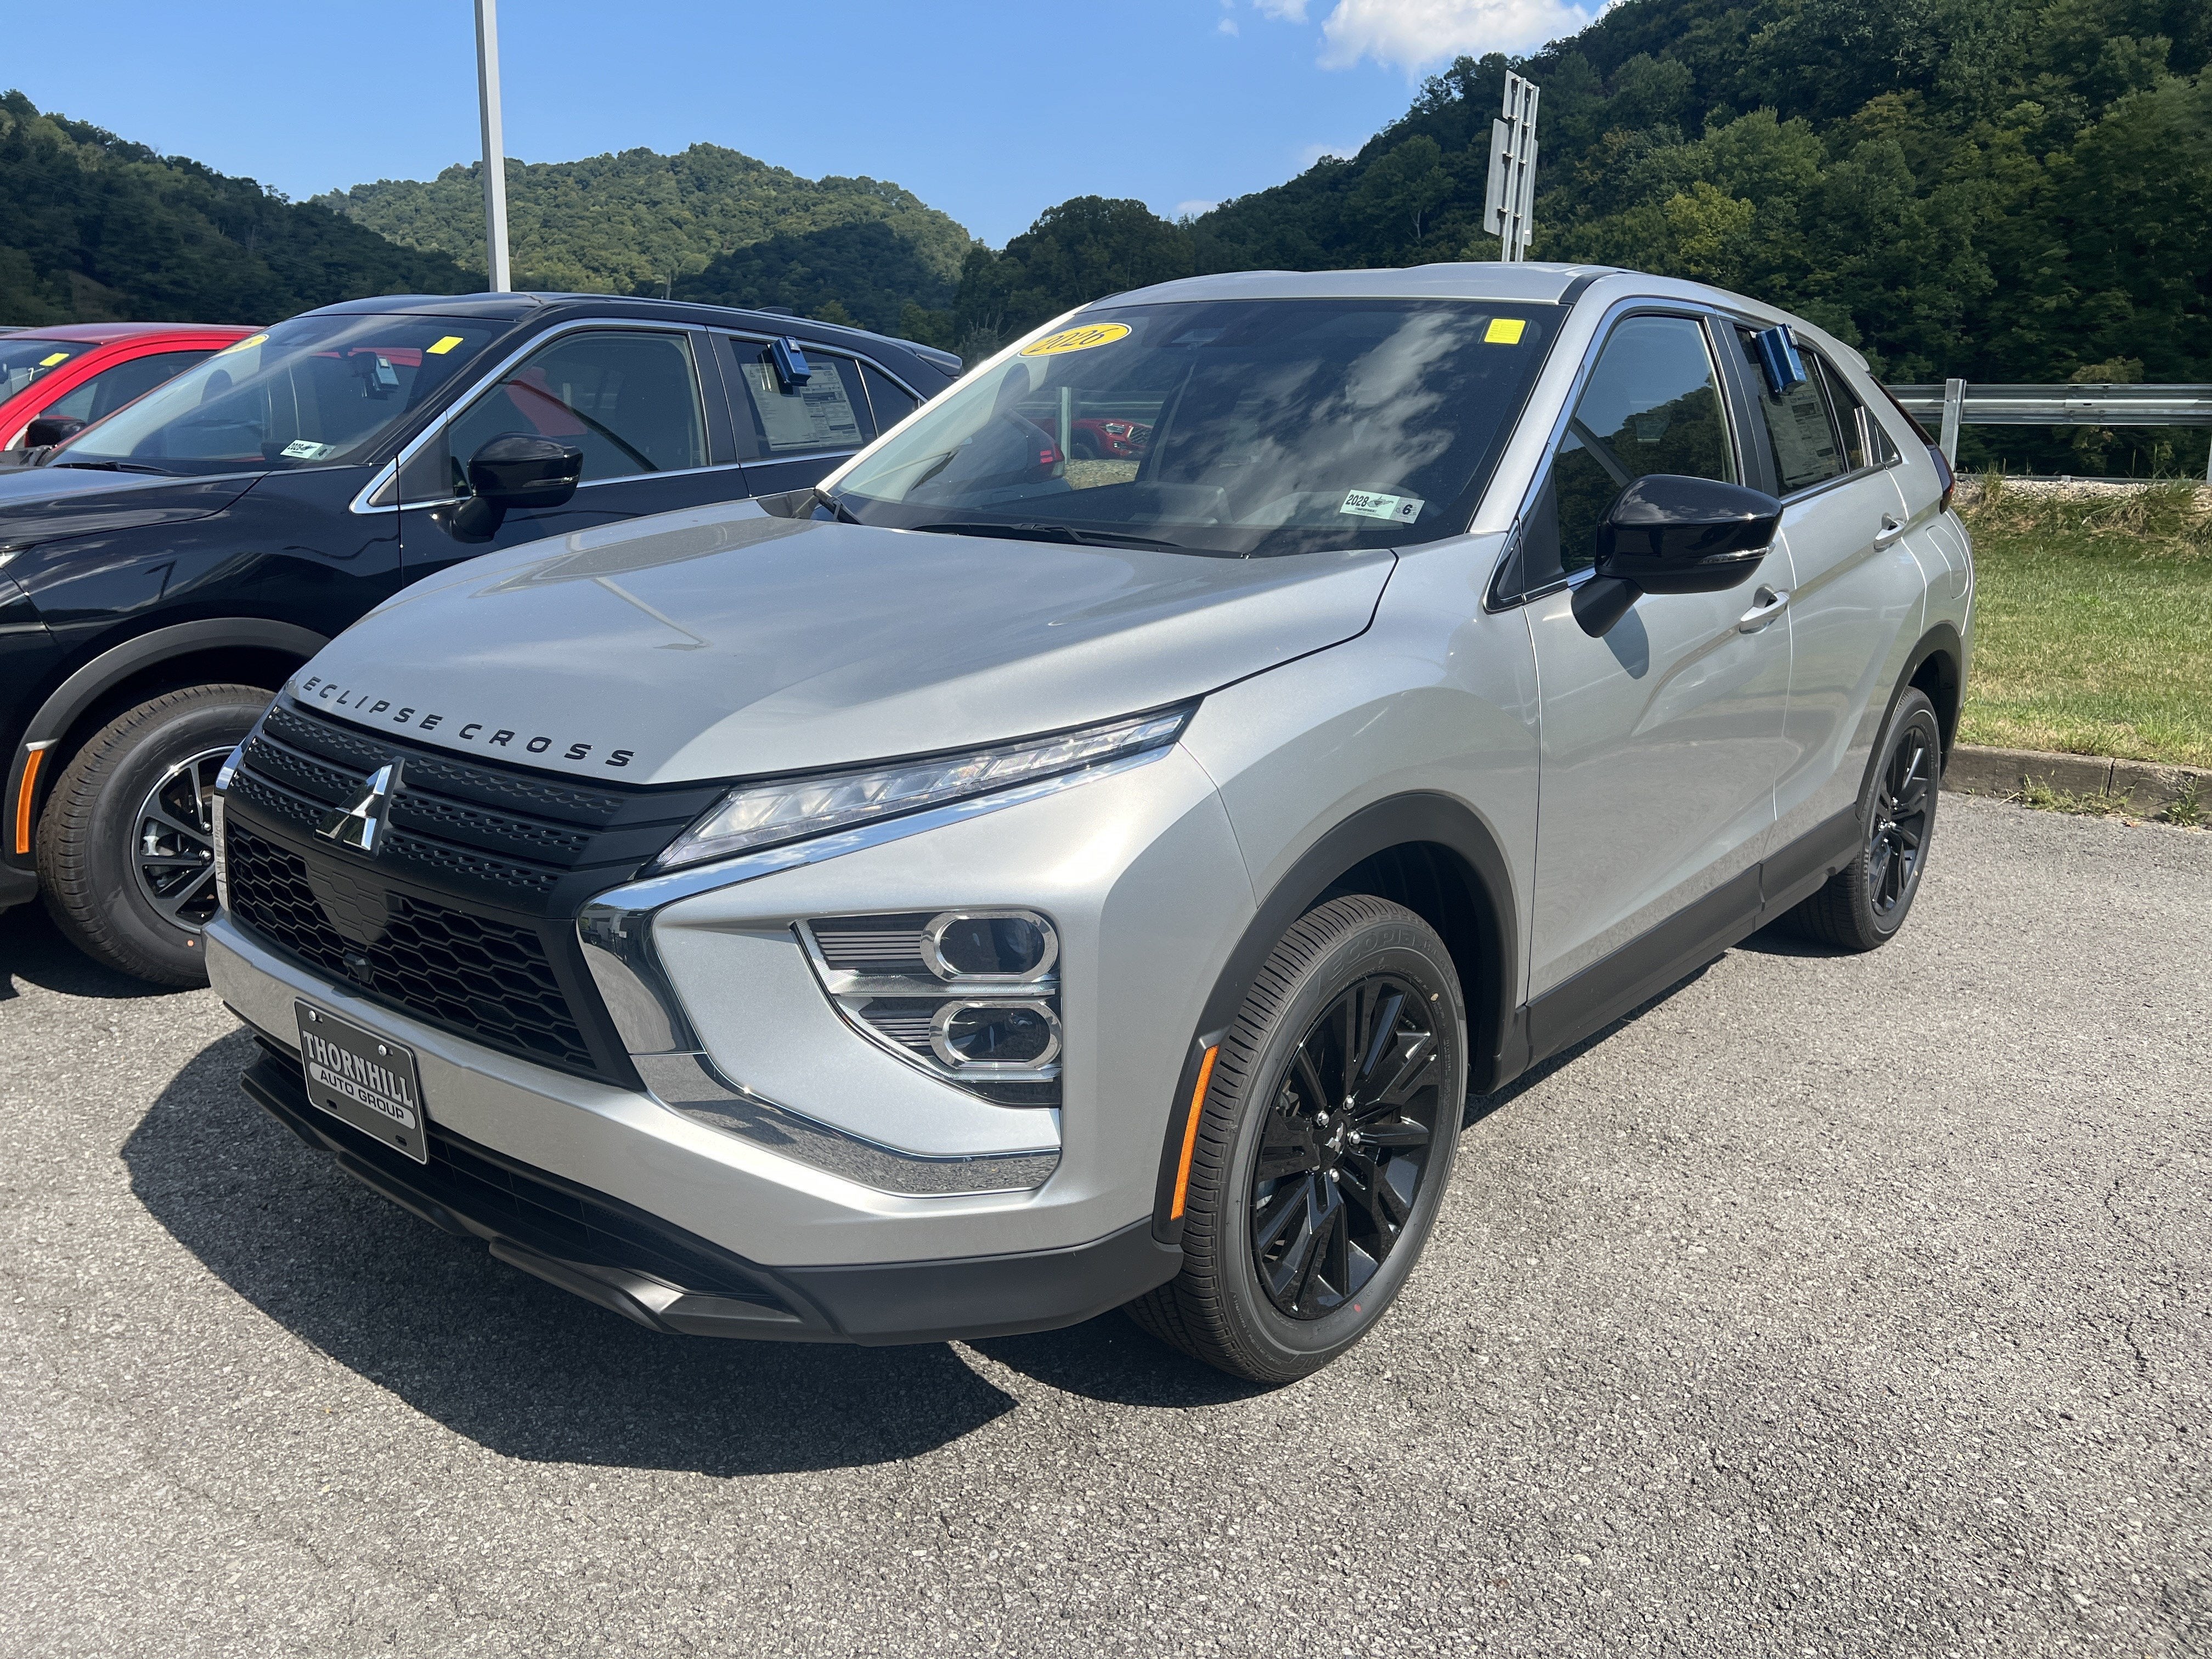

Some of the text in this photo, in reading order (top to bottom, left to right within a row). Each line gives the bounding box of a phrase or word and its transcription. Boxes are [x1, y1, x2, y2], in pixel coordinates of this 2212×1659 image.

[1026, 328, 1119, 354] 2026
[1345, 494, 1370, 507] 2028
[1402, 504, 1413, 515] 6
[303, 676, 635, 766] ECLIPSE CROSS
[302, 1030, 415, 1109] THORNHILL
[320, 1070, 404, 1119] AUTO GROUP
